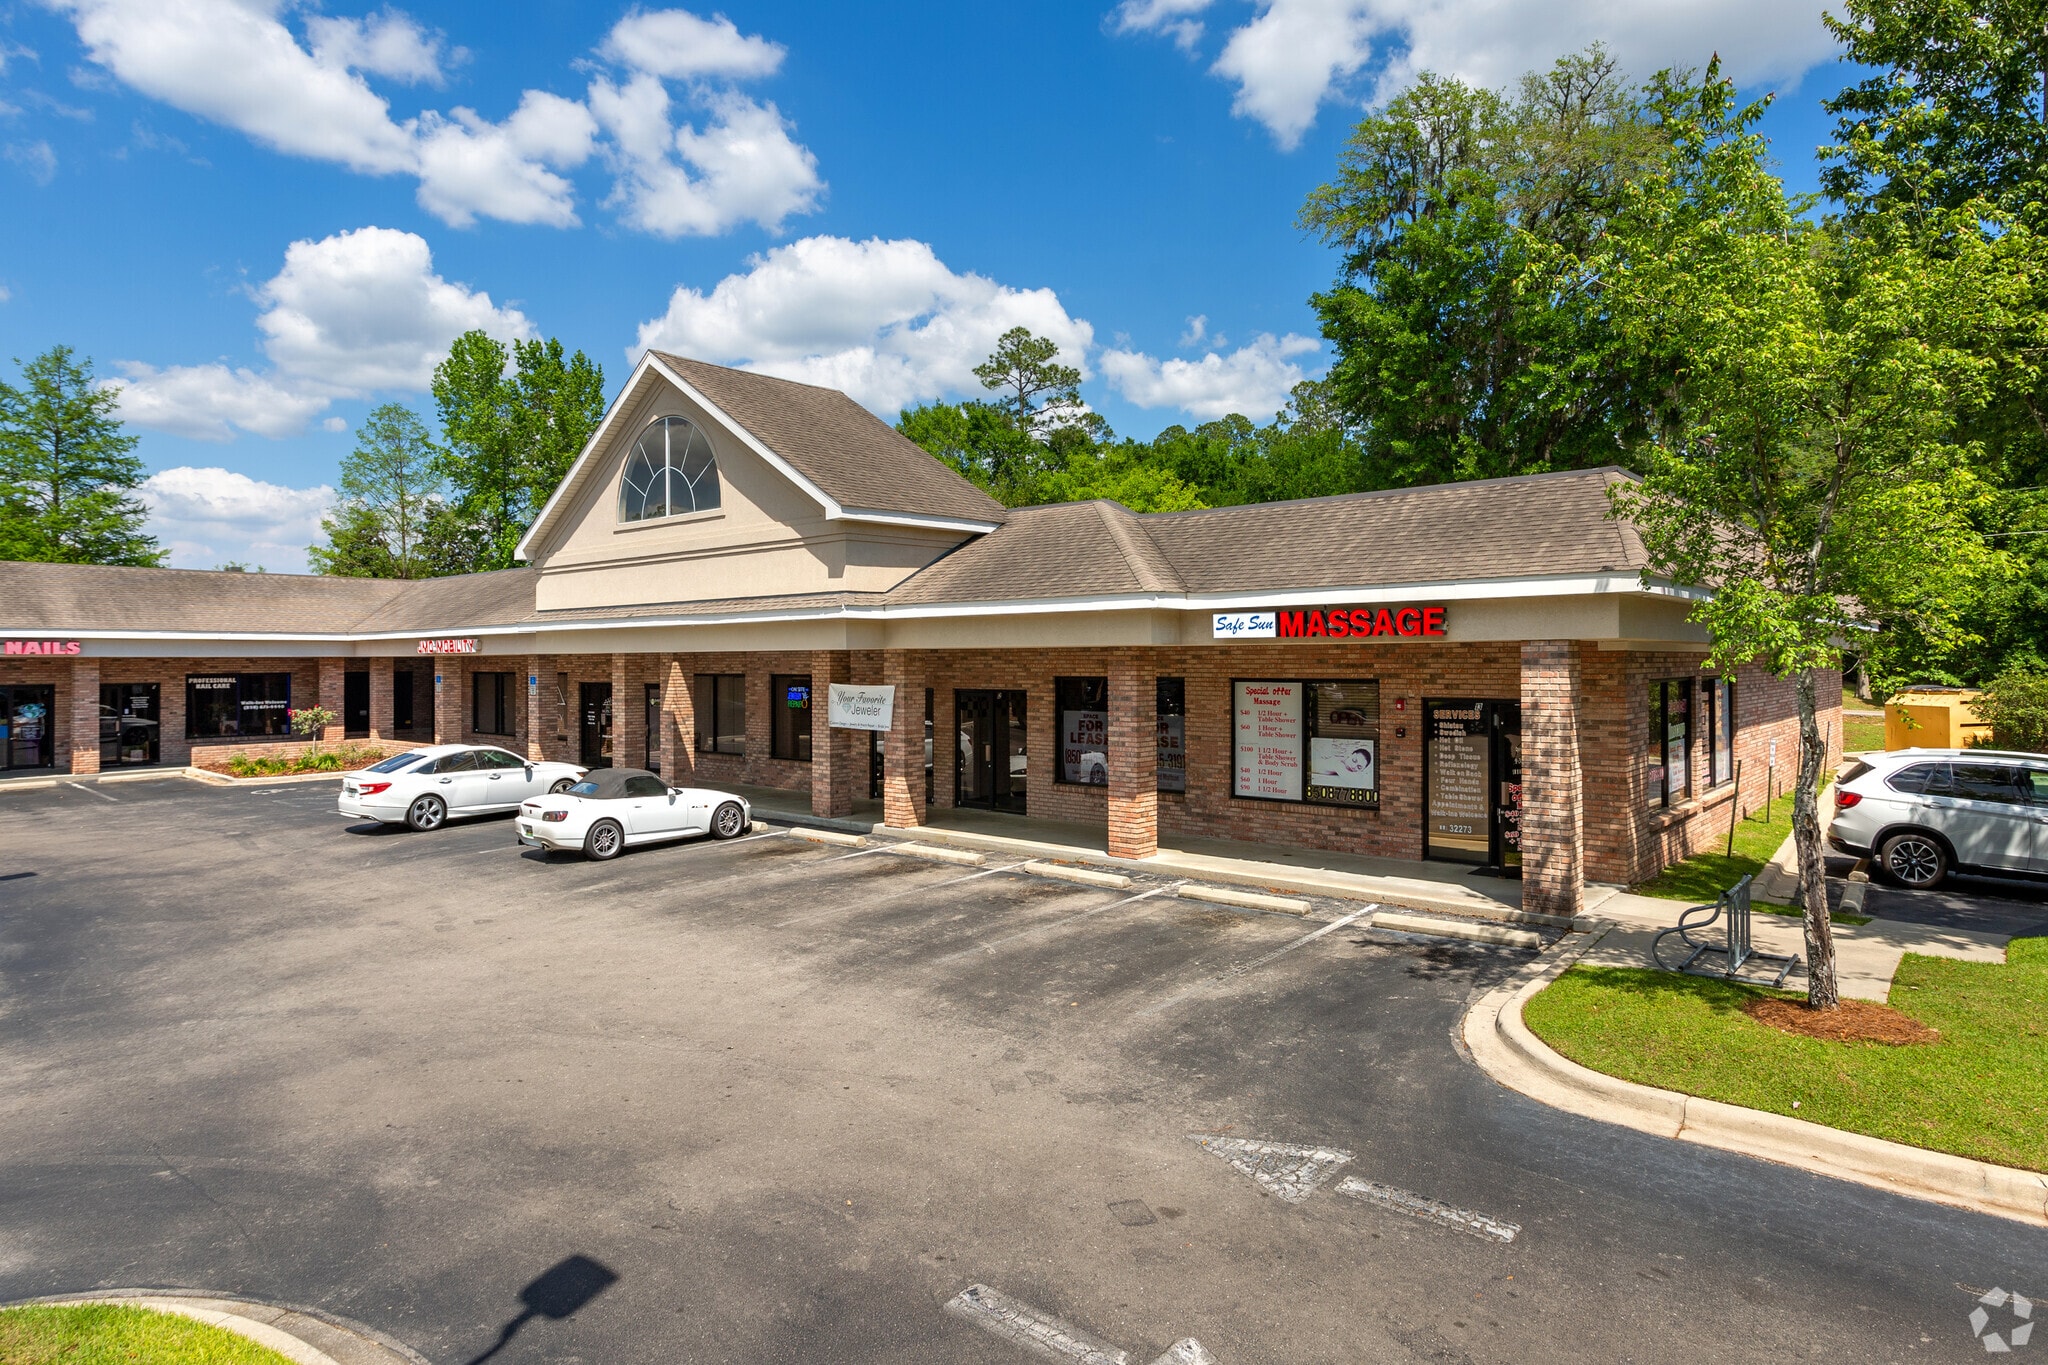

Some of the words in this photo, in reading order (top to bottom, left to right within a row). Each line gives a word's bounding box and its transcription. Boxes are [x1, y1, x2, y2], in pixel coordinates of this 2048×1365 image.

[1215, 616, 1245, 635] Safe
[1248, 615, 1274, 630] Sun
[1279, 607, 1447, 638] MASSAGE
[4, 640, 81, 655] NAILS
[1245, 686, 1270, 697] Special
[1272, 686, 1292, 696] offer
[837, 690, 855, 706] Your
[855, 691, 887, 705] Favorite
[1253, 697, 1281, 706] Massage
[850, 703, 882, 717] Jeweler
[1432, 709, 1481, 720] SERVICES
[1078, 719, 1104, 732] FOR
[1274, 731, 1297, 739] Shower
[1439, 729, 1467, 737] Swedish
[1439, 736, 1451, 744] Hot
[1272, 747, 1288, 755] Hour
[1439, 744, 1451, 752] Hot
[1454, 744, 1474, 752] Stone
[1274, 754, 1297, 762] Shower
[1439, 752, 1456, 761] Deep
[1459, 752, 1481, 761] Tissue
[1264, 760, 1279, 768] Body
[1439, 761, 1479, 770] Reflexology
[1267, 769, 1284, 777] Hour
[1439, 768, 1456, 776] Walk
[1440, 776, 1456, 784] Four
[1459, 777, 1480, 785] Hands
[1440, 784, 1482, 794] Combination
[1440, 792, 1458, 800] Table
[1458, 793, 1484, 802] Shower
[1431, 799, 1478, 810] Appointments
[1449, 824, 1473, 834] 32273
